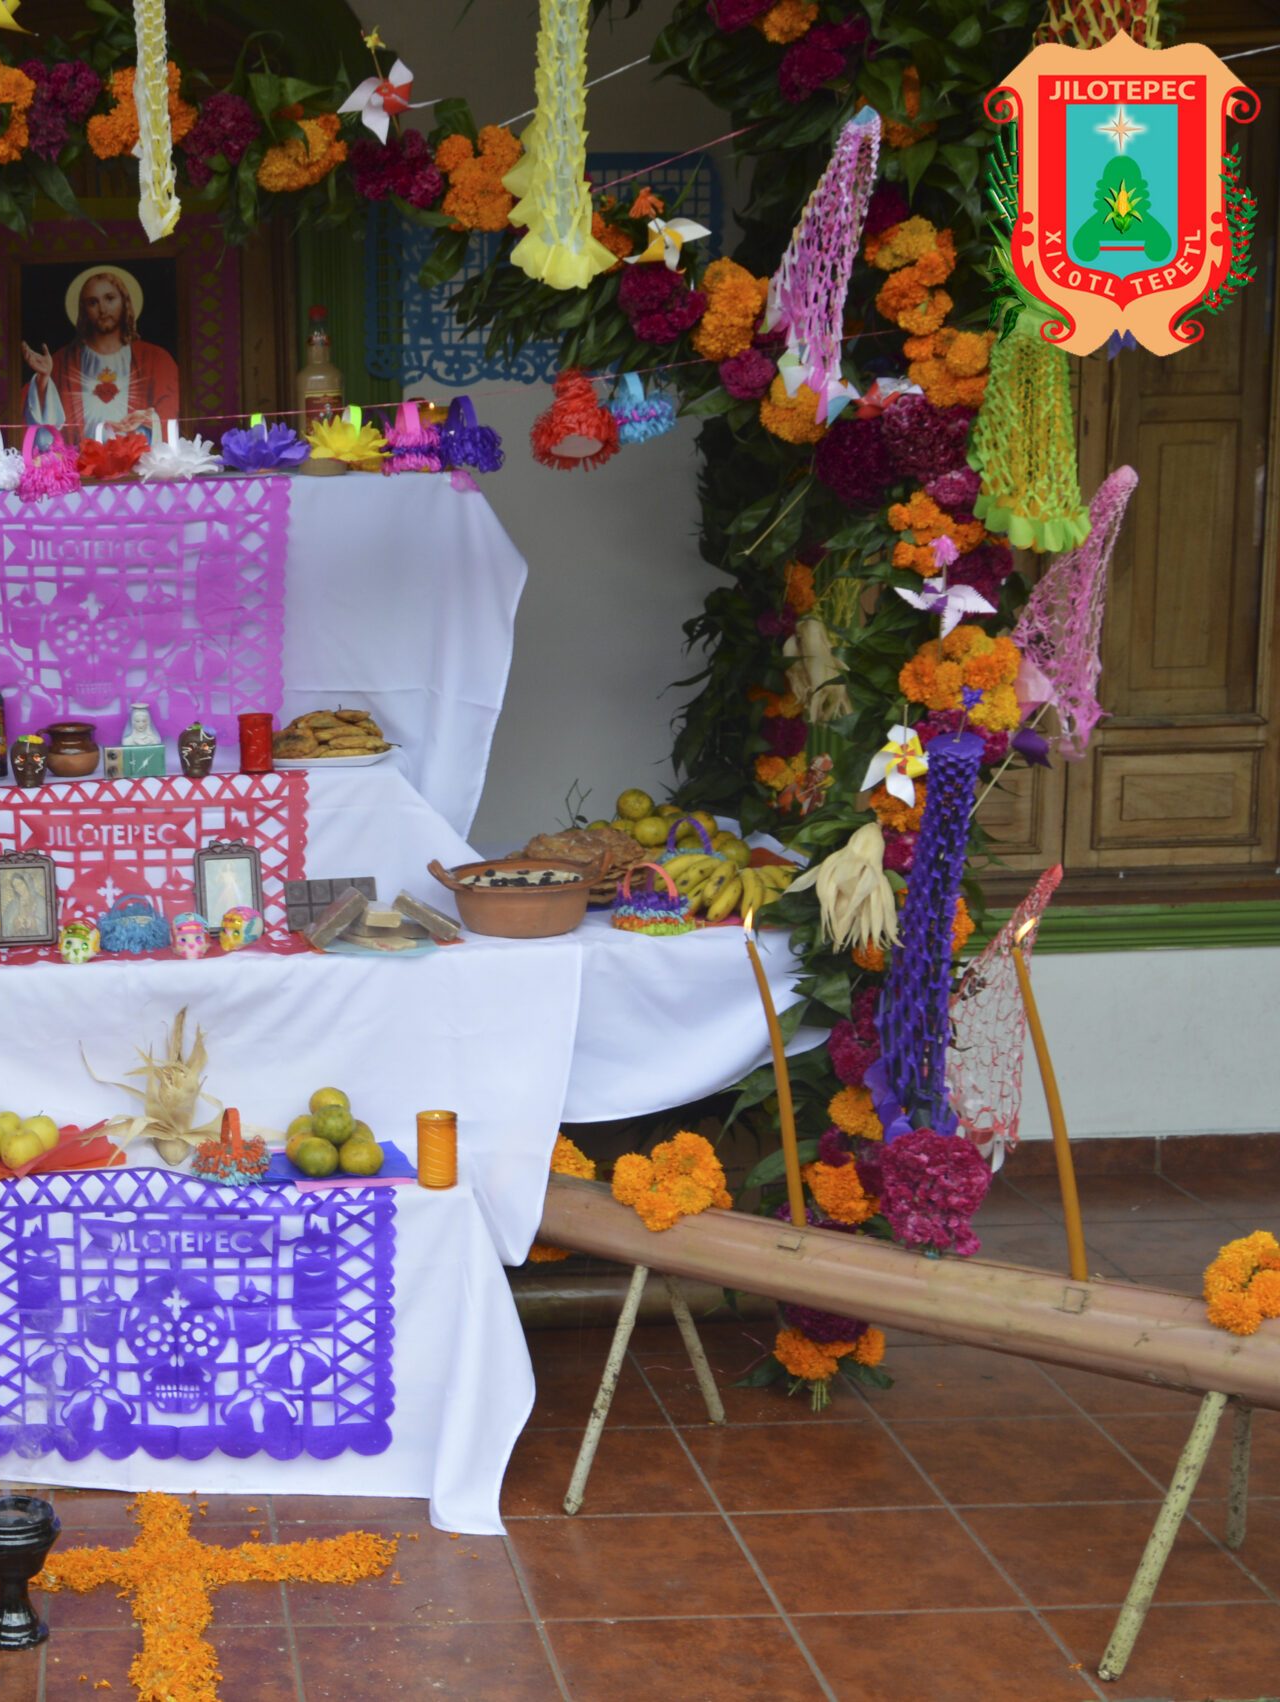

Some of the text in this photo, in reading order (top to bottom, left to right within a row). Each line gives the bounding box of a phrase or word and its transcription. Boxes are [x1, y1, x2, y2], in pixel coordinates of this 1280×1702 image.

[26, 537, 158, 560] JILOTEPEC
[45, 823, 177, 846] JILOTEPEC
[107, 1229, 254, 1253] JILOTEPEC
